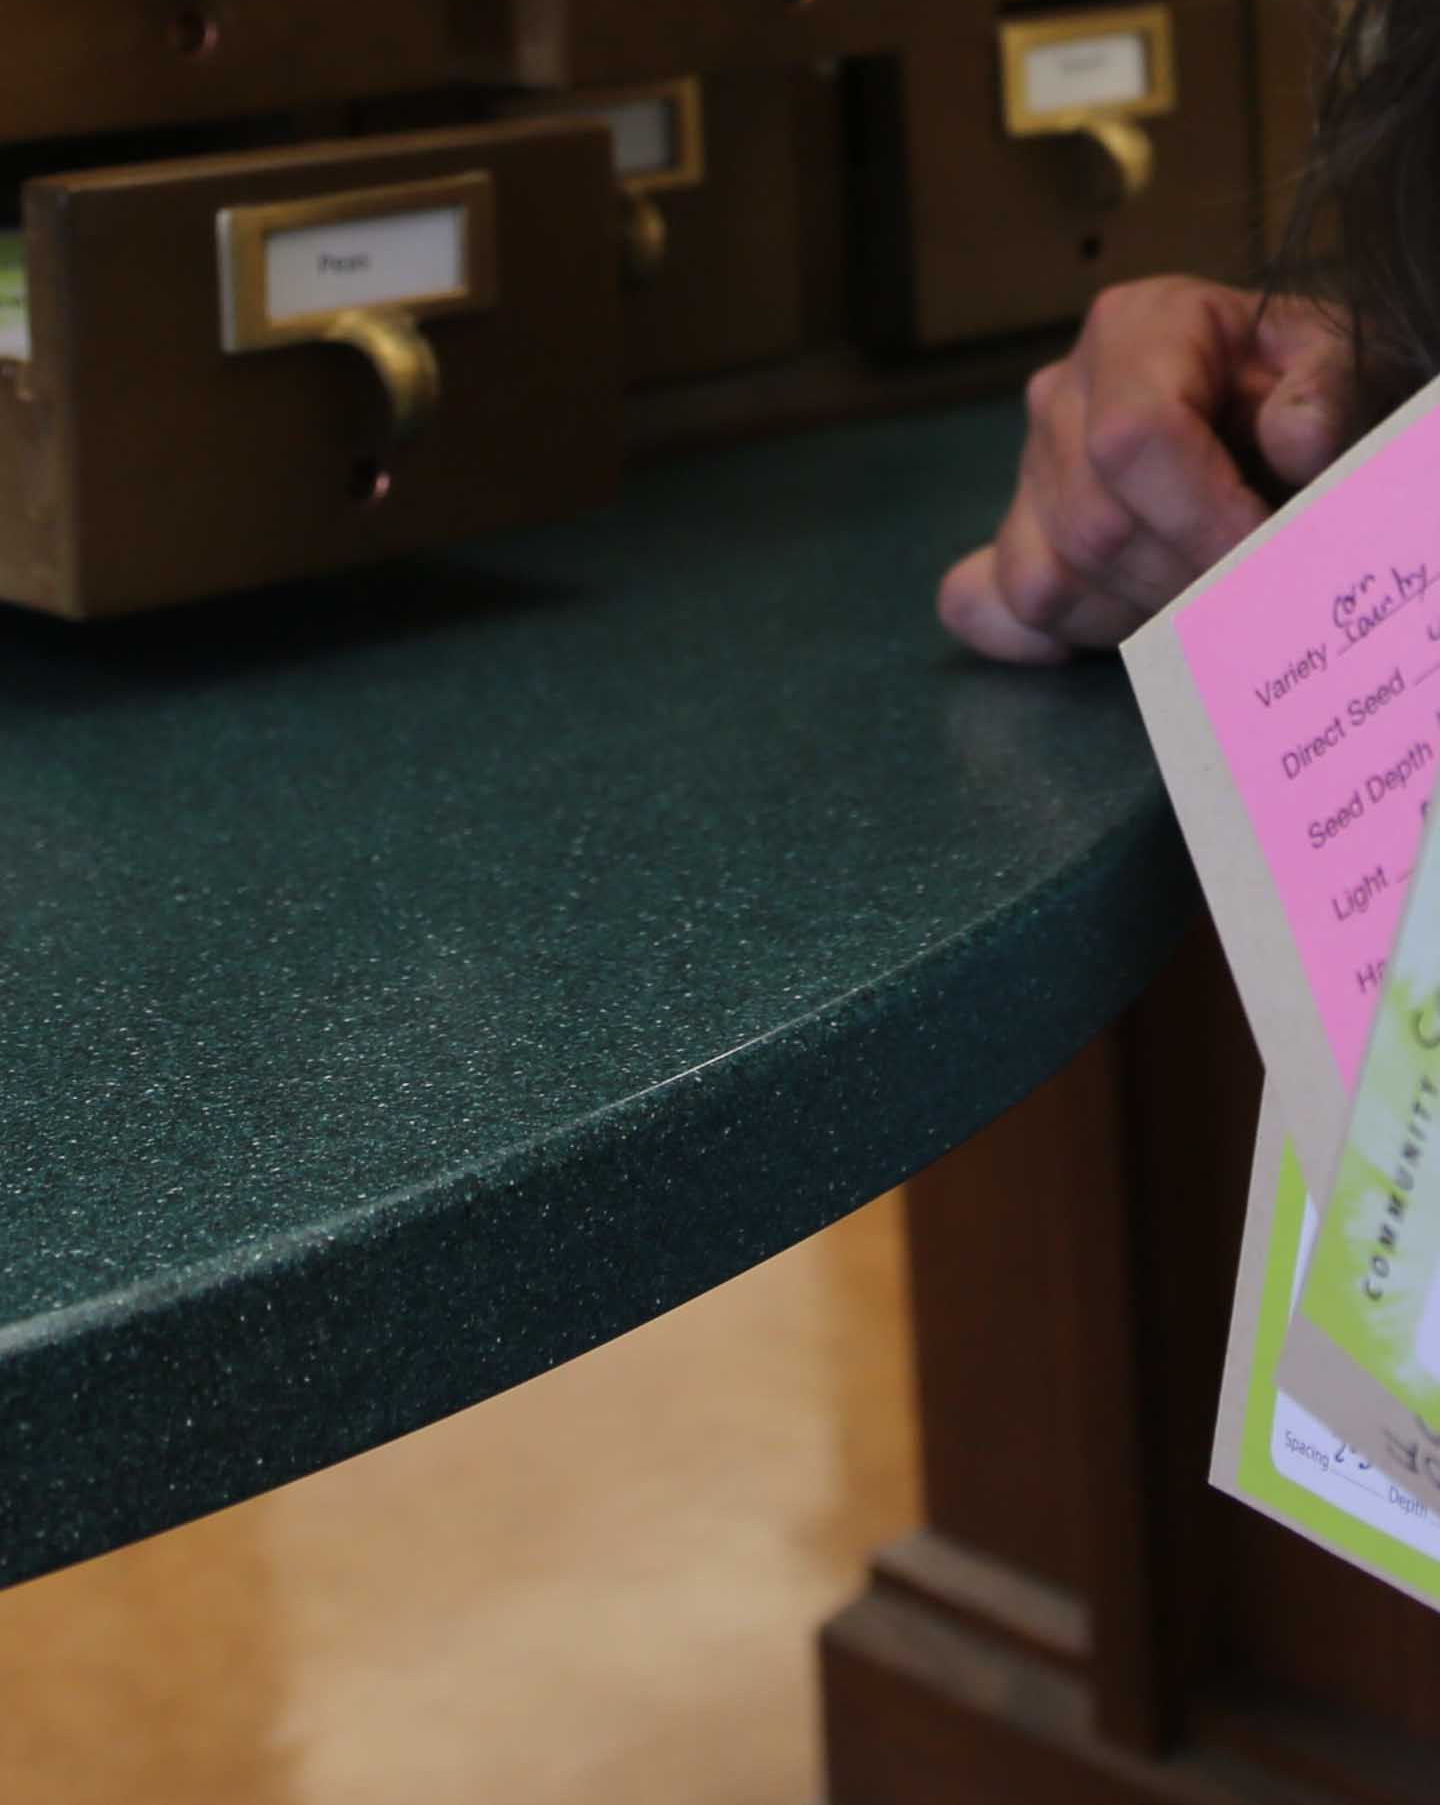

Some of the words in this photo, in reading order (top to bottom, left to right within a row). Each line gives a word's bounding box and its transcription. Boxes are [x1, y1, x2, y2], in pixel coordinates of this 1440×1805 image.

[1252, 642, 1329, 710] Variety
[1279, 715, 1348, 782] Direct
[1344, 666, 1407, 728] Seed
[1306, 788, 1366, 851] Seed
[1363, 740, 1435, 806] Depth
[1330, 864, 1390, 923] Light
[1363, 1077, 1440, 1302] COMMUNITY
[1283, 1428, 1331, 1474] Spacing
